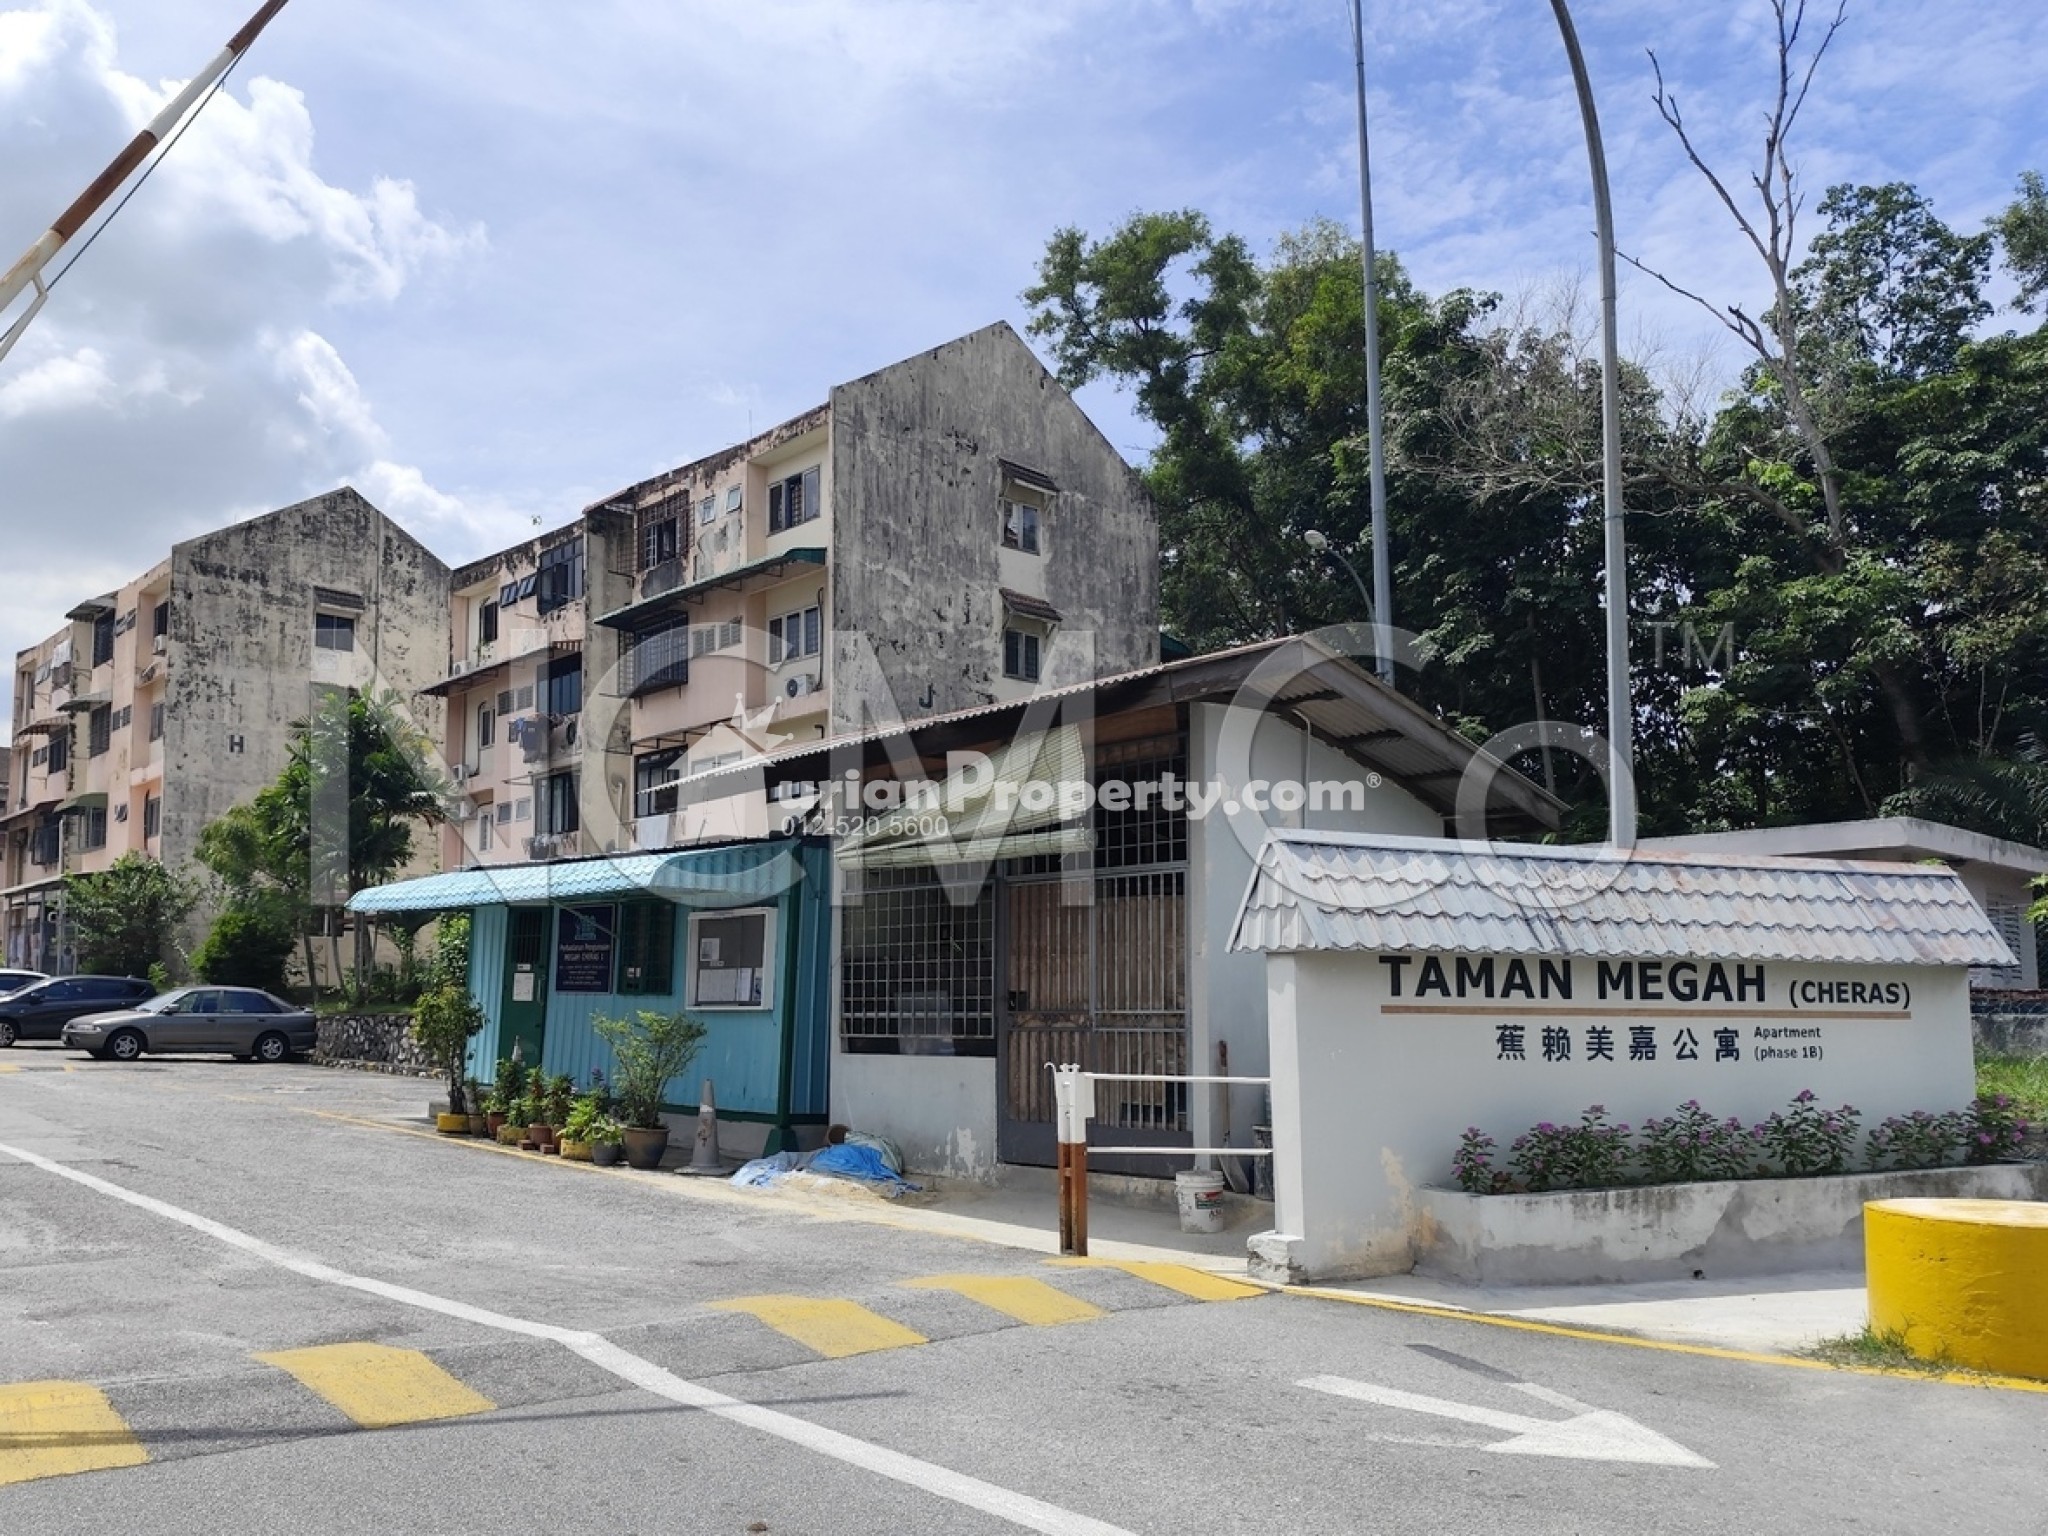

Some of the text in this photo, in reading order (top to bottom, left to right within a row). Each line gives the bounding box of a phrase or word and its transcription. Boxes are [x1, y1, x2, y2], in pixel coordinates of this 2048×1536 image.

[918, 683, 935, 709] J
[229, 734, 244, 753] H
[1379, 955, 1911, 1009] TAMAN MEGAH (CHERAS)
[1753, 1026, 1822, 1039] Apartment
[1754, 1046, 1823, 1061] (phase 1B)
